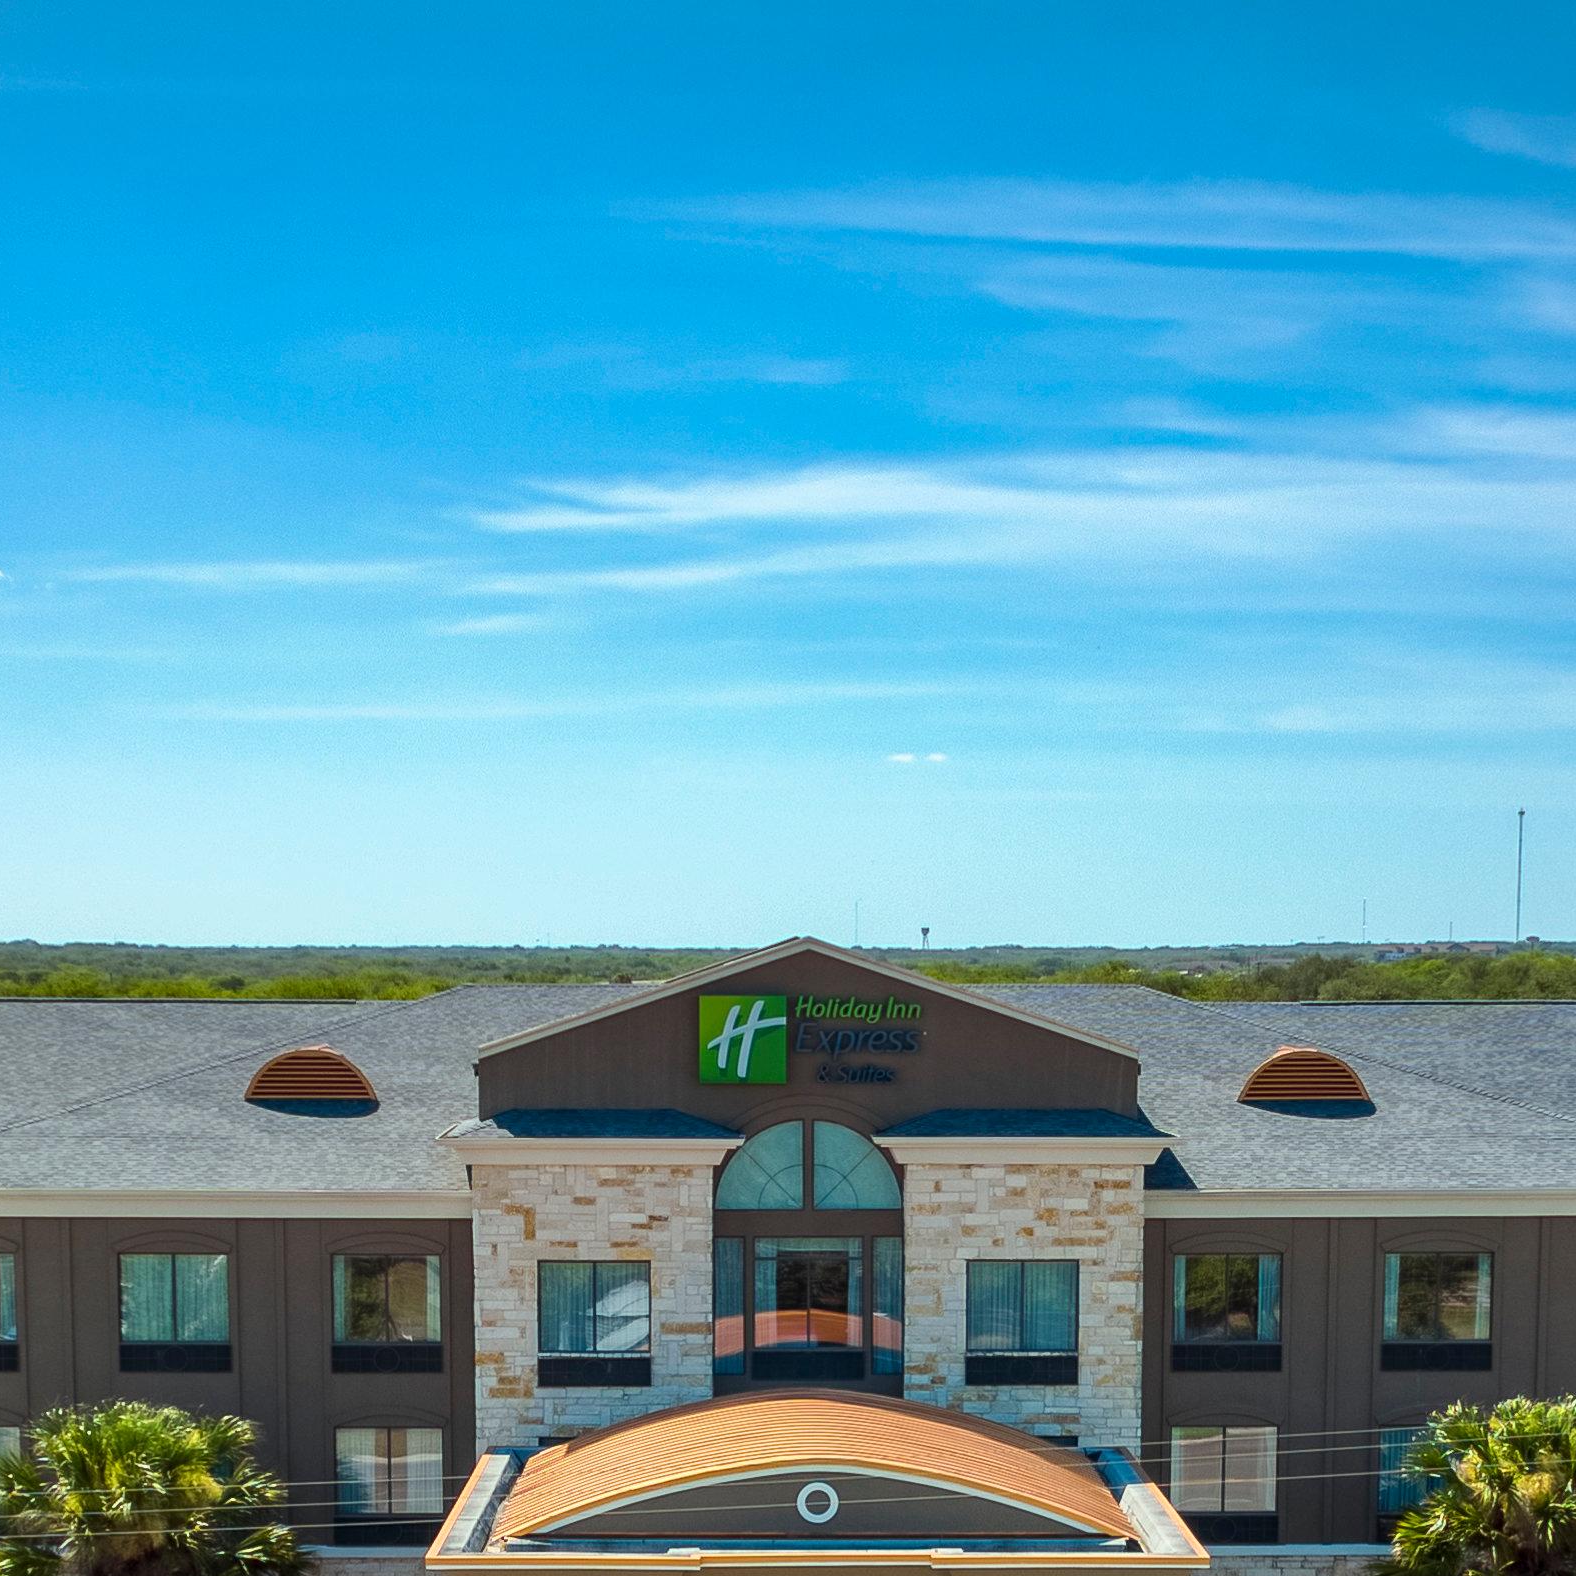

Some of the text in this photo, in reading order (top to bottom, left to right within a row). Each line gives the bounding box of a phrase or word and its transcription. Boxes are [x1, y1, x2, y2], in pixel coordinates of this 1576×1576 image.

[794, 995, 922, 1024] Holiday Inn
[795, 1022, 921, 1061] Express
[817, 1063, 898, 1084] & Suites
